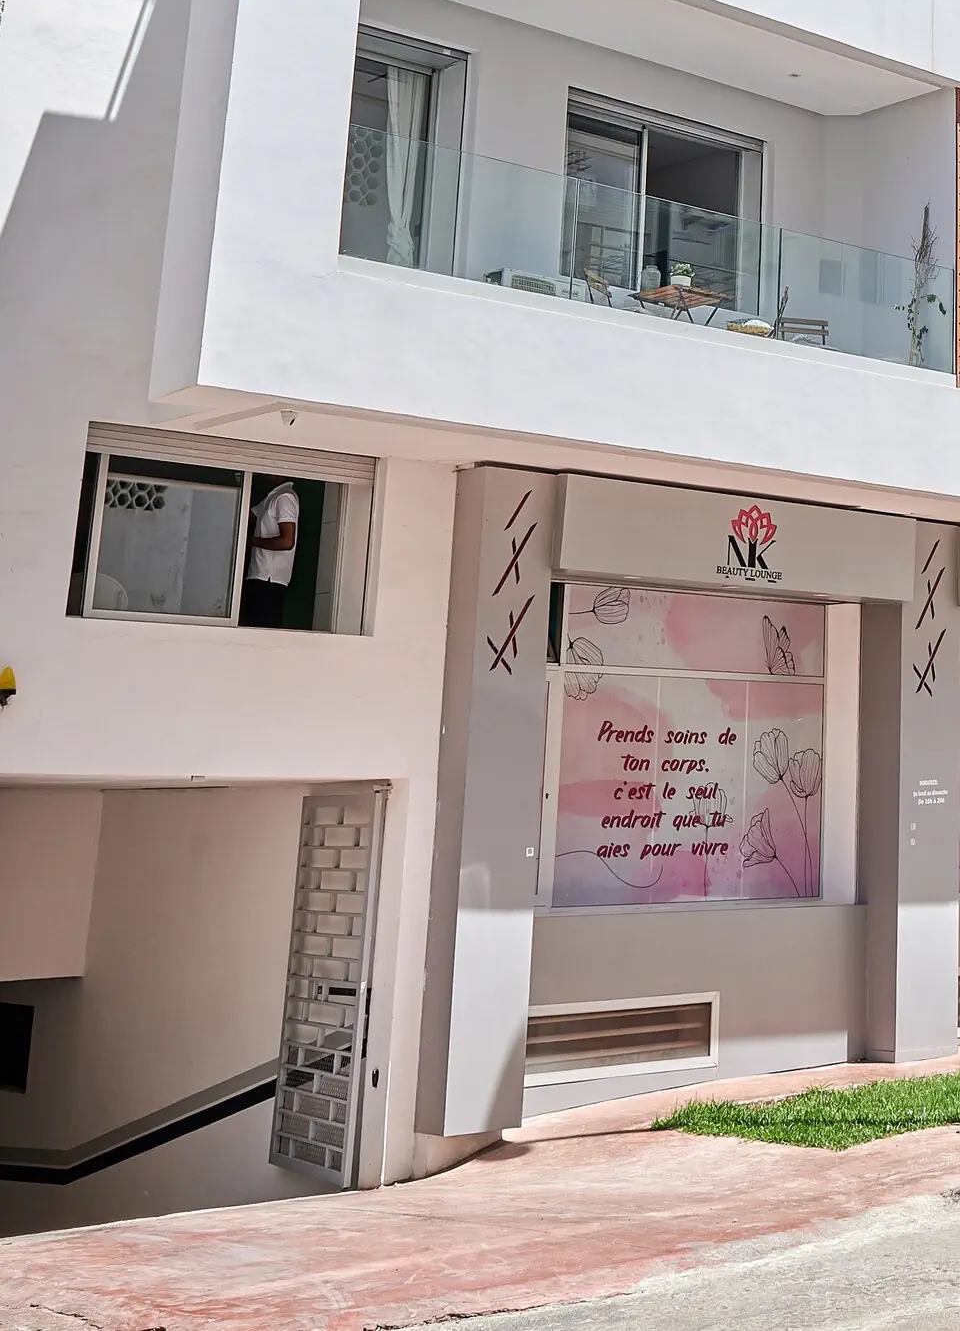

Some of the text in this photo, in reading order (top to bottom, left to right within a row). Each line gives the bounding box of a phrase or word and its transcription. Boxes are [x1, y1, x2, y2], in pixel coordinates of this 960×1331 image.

[728, 535, 776, 569] NK
[716, 566, 783, 580] BEAUTY LOUNGE
[597, 720, 737, 746] Prends soins de
[621, 753, 710, 775] ton corps.
[662, 781, 676, 800] le
[686, 782, 719, 800] seul
[601, 809, 727, 831] endroit que tu
[597, 840, 729, 860] aies pour vivre
